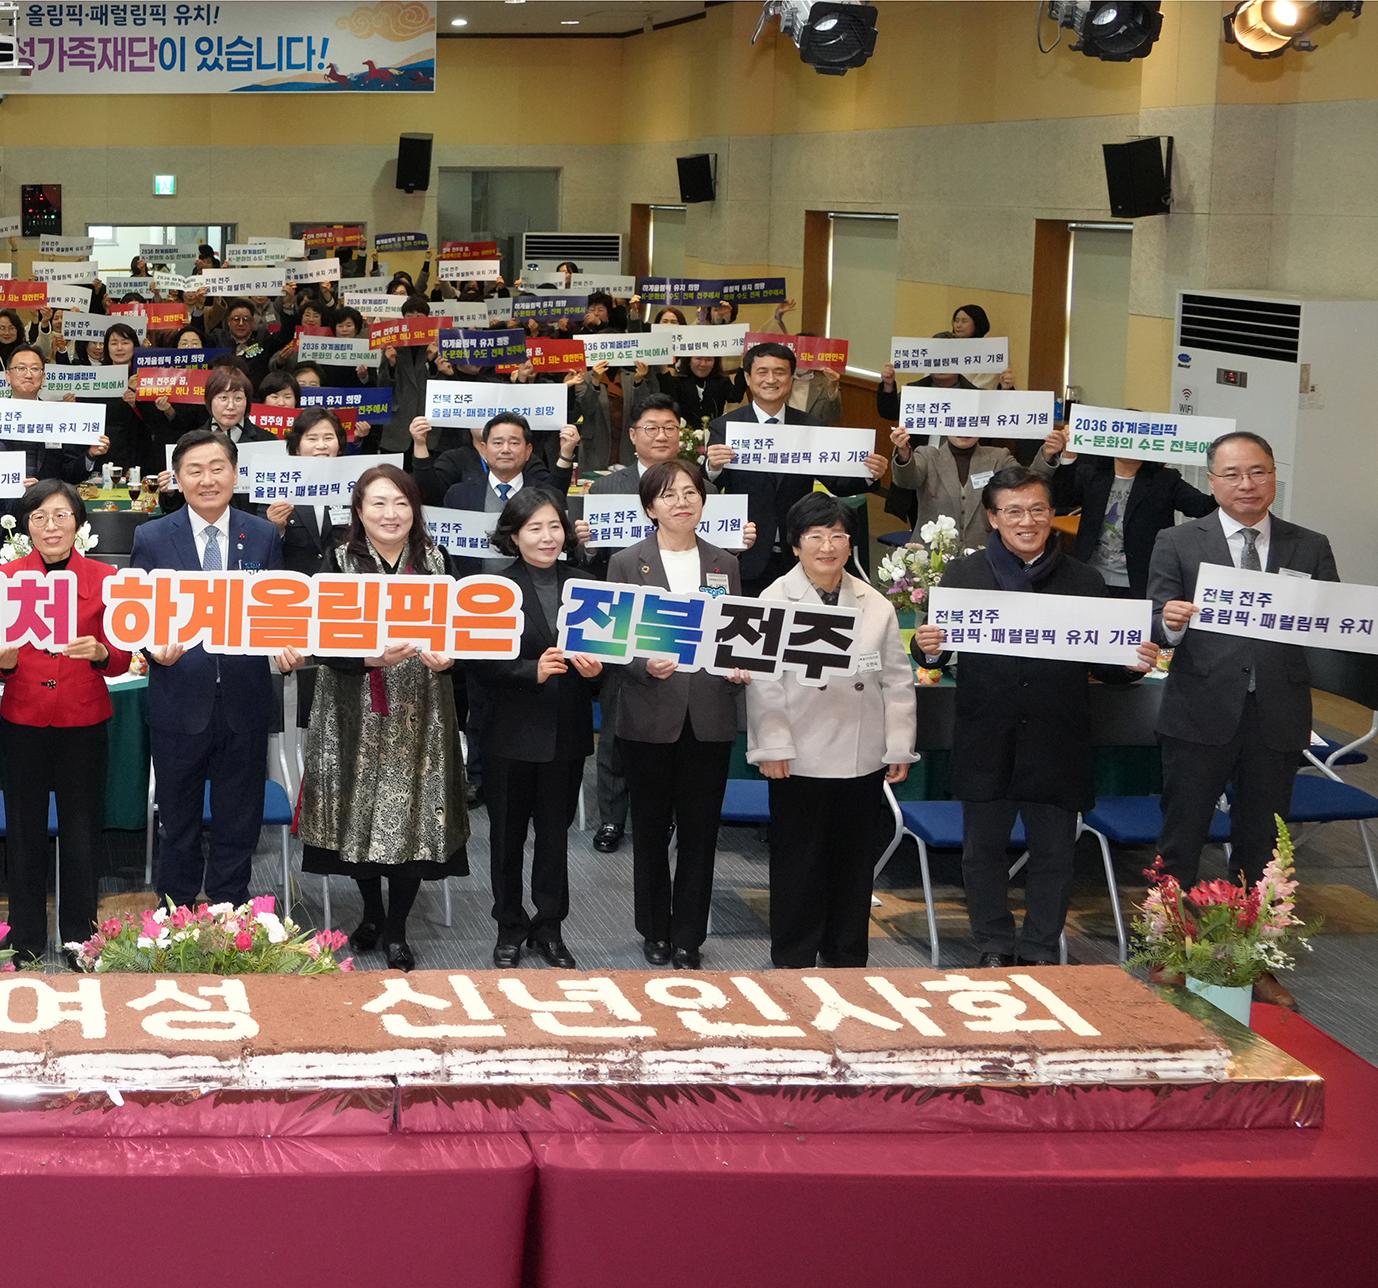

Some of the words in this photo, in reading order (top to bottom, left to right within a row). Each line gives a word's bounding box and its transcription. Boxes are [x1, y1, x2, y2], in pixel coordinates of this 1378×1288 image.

[173, 4, 220, 25] 유치!
[195, 37, 330, 71] 있습니다!
[302, 342, 319, 351] 2036
[600, 339, 638, 350] 하계올림픽
[350, 351, 377, 360] 전북에서
[636, 348, 669, 358] 전북에서
[894, 349, 908, 357] 전북
[911, 349, 928, 357] 전주
[987, 354, 1003, 363] 기원
[58, 372, 96, 380] 하계올림픽
[75, 381, 90, 390] 수도
[93, 381, 125, 390] 전북에서
[433, 394, 451, 403] 전북
[454, 394, 473, 403] 전주
[358, 403, 388, 414] 전주에서
[535, 406, 554, 416] 희망
[906, 403, 925, 414] 전북
[930, 402, 951, 413] 전주
[1179, 403, 1193, 414] WIFI
[5, 411, 22, 420] 전주
[1027, 413, 1048, 425] 기원
[82, 422, 100, 432] 기원
[1075, 419, 1106, 432] 2036
[1112, 421, 1176, 436] 하계올림픽
[731, 440, 750, 450] 전북
[754, 439, 774, 450] 전주
[1074, 434, 1133, 449] K-문화의
[1139, 439, 1164, 451] 수도
[1, 472, 20, 484] 기원
[255, 472, 275, 483] 전북
[280, 471, 302, 483] 전주
[589, 512, 609, 525] 전북
[614, 510, 637, 522] 전주
[718, 519, 740, 532] 기원
[1203, 588, 1234, 605] 전북
[1239, 591, 1272, 608] 전주
[110, 576, 517, 652] 하계올림픽은
[935, 610, 963, 624] 전북
[969, 609, 999, 623] 전주
[1199, 607, 1330, 632] 올림픽·패럴림픽
[1340, 618, 1373, 635] 유치
[565, 586, 705, 665] 전북
[713, 603, 855, 679] 전주
[1066, 630, 1098, 645] 유치
[1109, 630, 1142, 645] 기원
[362, 971, 1101, 1039] 신년인사회
